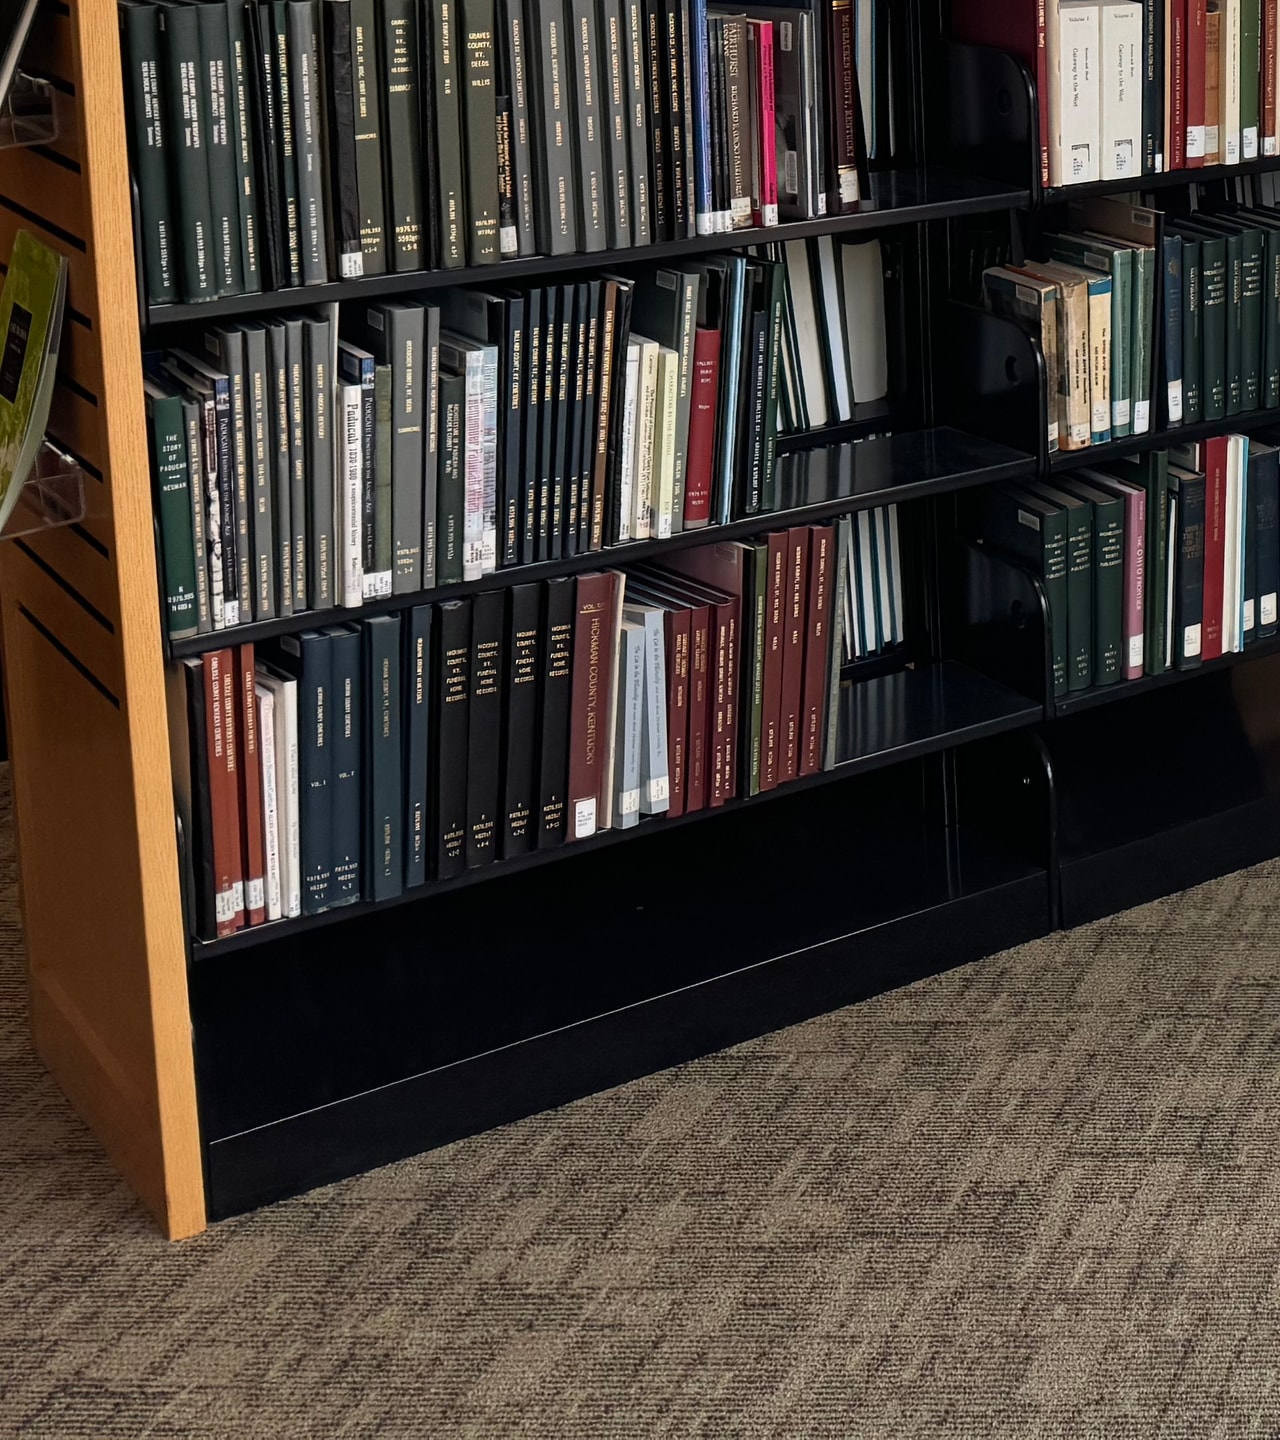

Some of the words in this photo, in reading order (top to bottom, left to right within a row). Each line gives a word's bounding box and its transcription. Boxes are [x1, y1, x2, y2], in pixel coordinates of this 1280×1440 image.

[729, 23, 738, 77] FAIRHURST
[844, 109, 855, 158] KENTUCKY
[166, 434, 177, 442] THE
[346, 404, 359, 444] Paducah
[160, 462, 187, 472] PADUCAH
[163, 443, 182, 452] STORY
[589, 618, 600, 664] HICKMAN
[587, 666, 599, 710] COUNTY,
[586, 712, 597, 765] KENTUCKY
